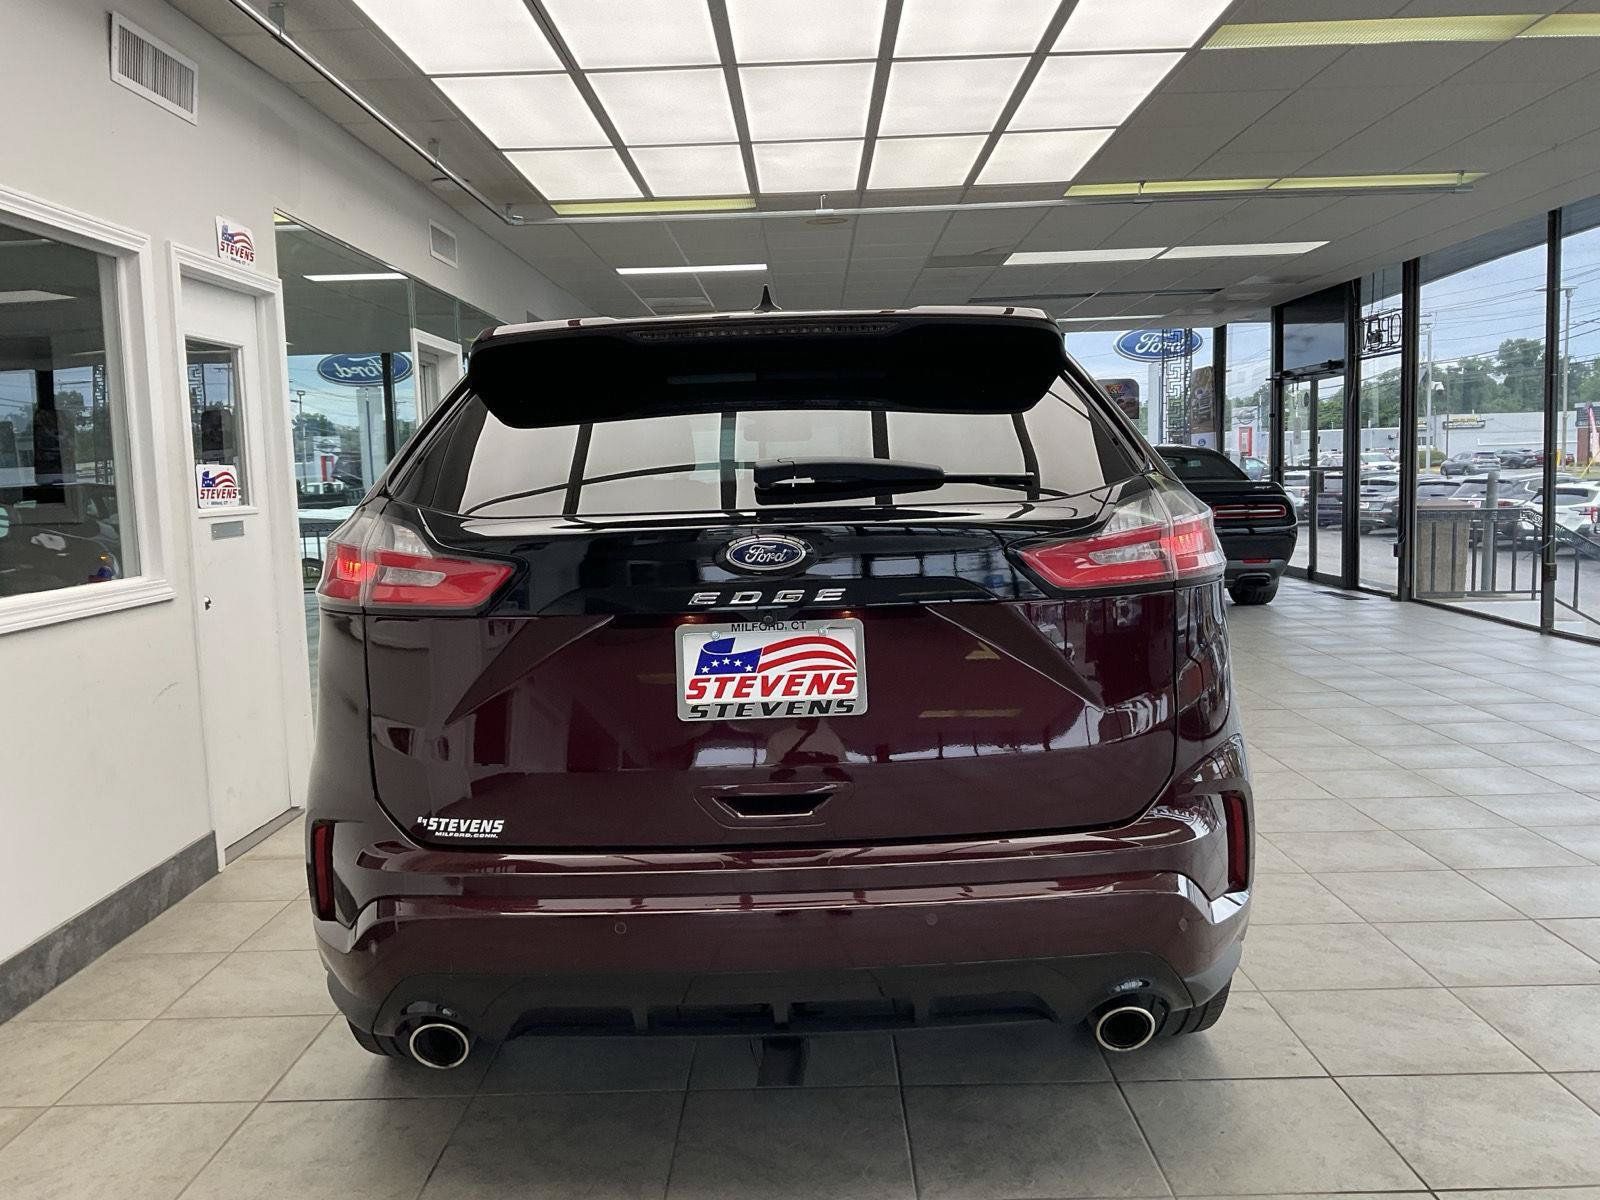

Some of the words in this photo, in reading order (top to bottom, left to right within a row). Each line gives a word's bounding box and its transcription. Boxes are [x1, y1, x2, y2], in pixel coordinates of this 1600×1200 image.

[220, 241, 255, 262] STEVENS
[1135, 332, 1185, 354] Ford
[200, 489, 238, 499] STEVENS
[745, 544, 788, 563] Ford
[687, 588, 847, 606] EDGE
[791, 620, 807, 630] CT
[686, 672, 858, 700] STEVENS
[688, 699, 856, 719] STEVENS
[427, 817, 505, 833] STEVENS
